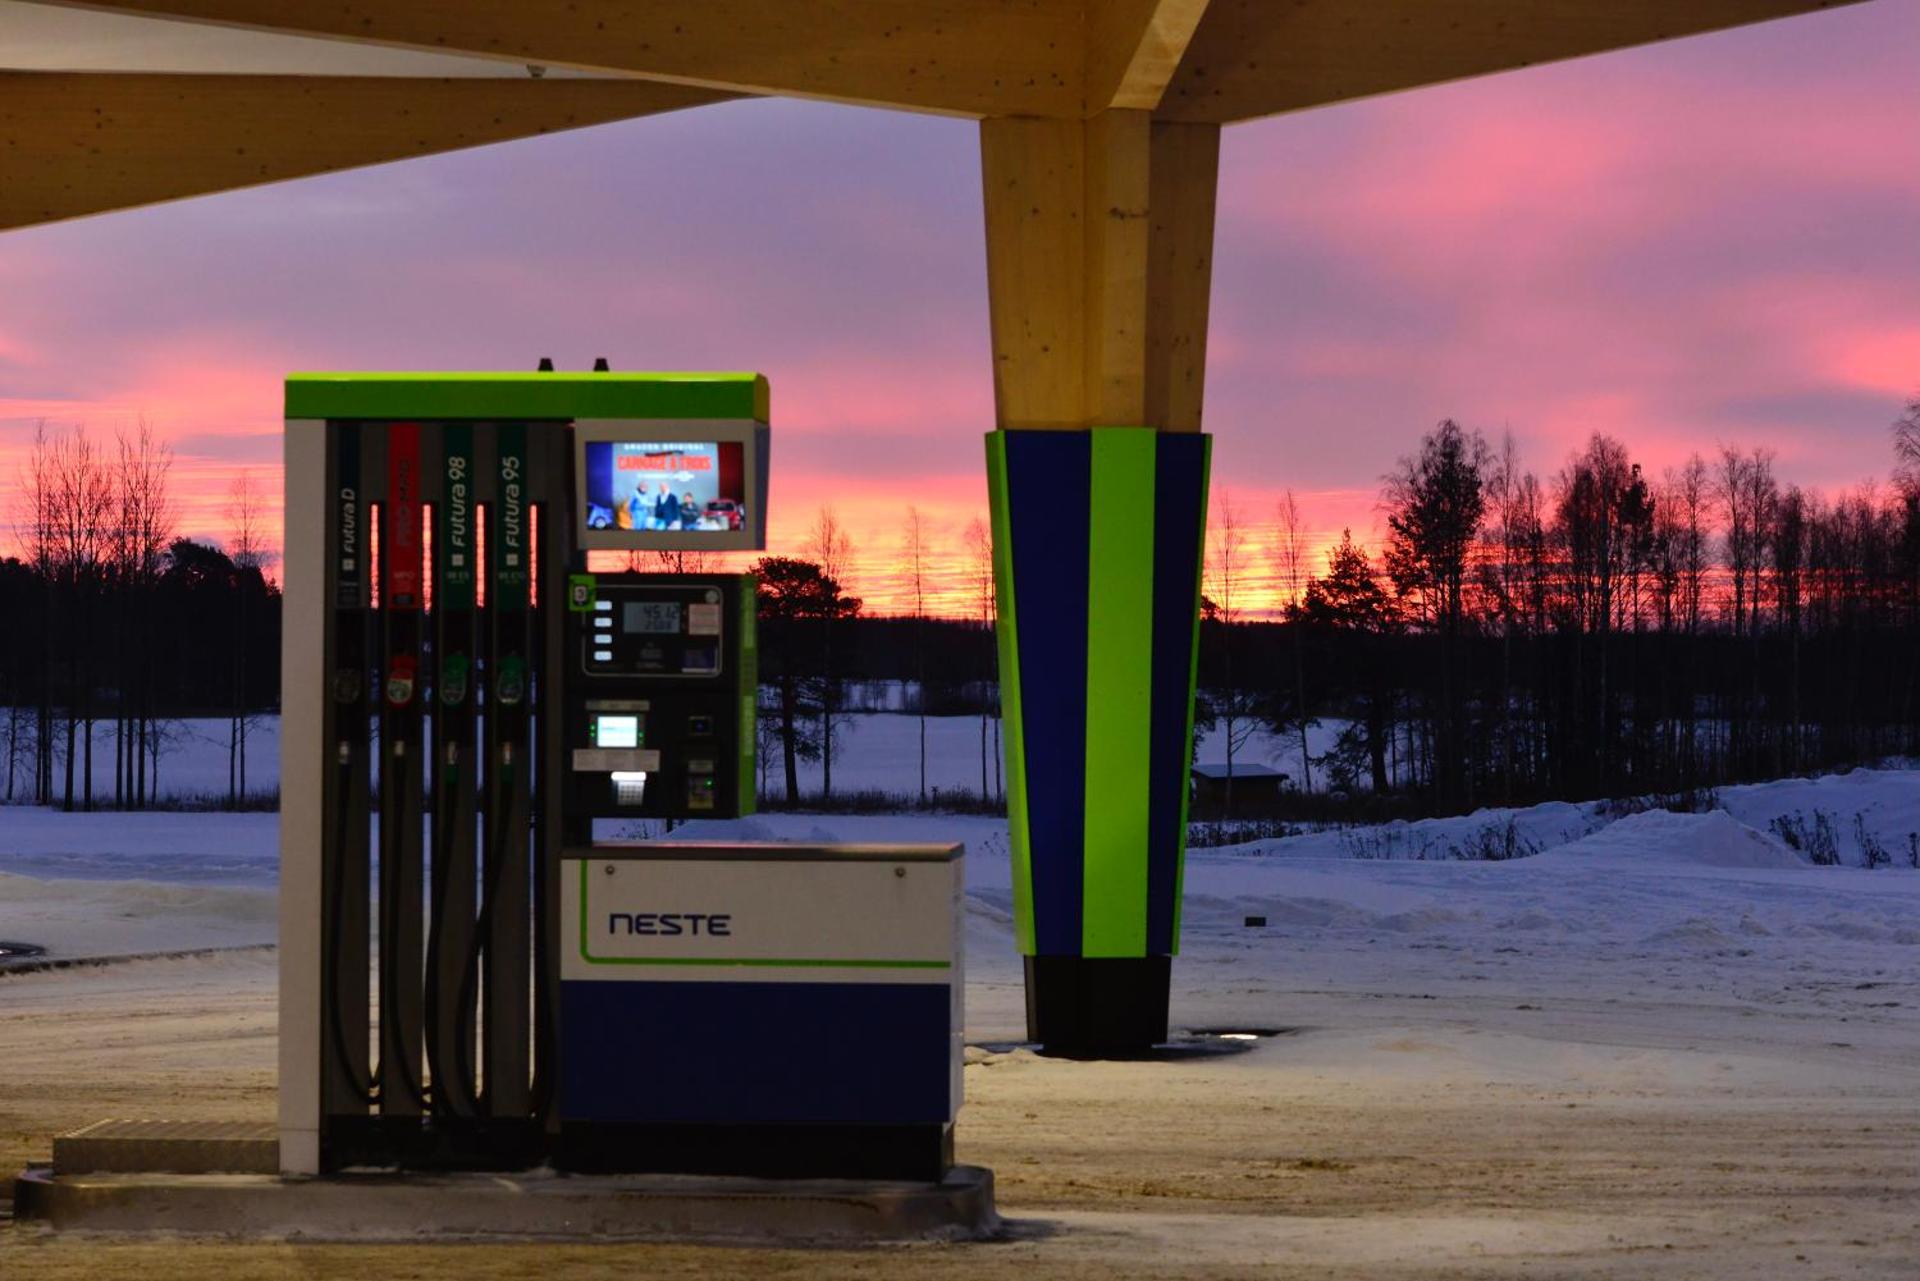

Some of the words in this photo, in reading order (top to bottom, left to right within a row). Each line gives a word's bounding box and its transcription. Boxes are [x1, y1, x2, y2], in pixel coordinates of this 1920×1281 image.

[448, 456, 466, 479] 98
[502, 456, 520, 480] 95
[341, 488, 355, 501] D
[451, 483, 466, 547] Futura
[504, 483, 520, 547] Futura
[343, 503, 355, 553] Futura
[609, 913, 731, 936] NESTE
